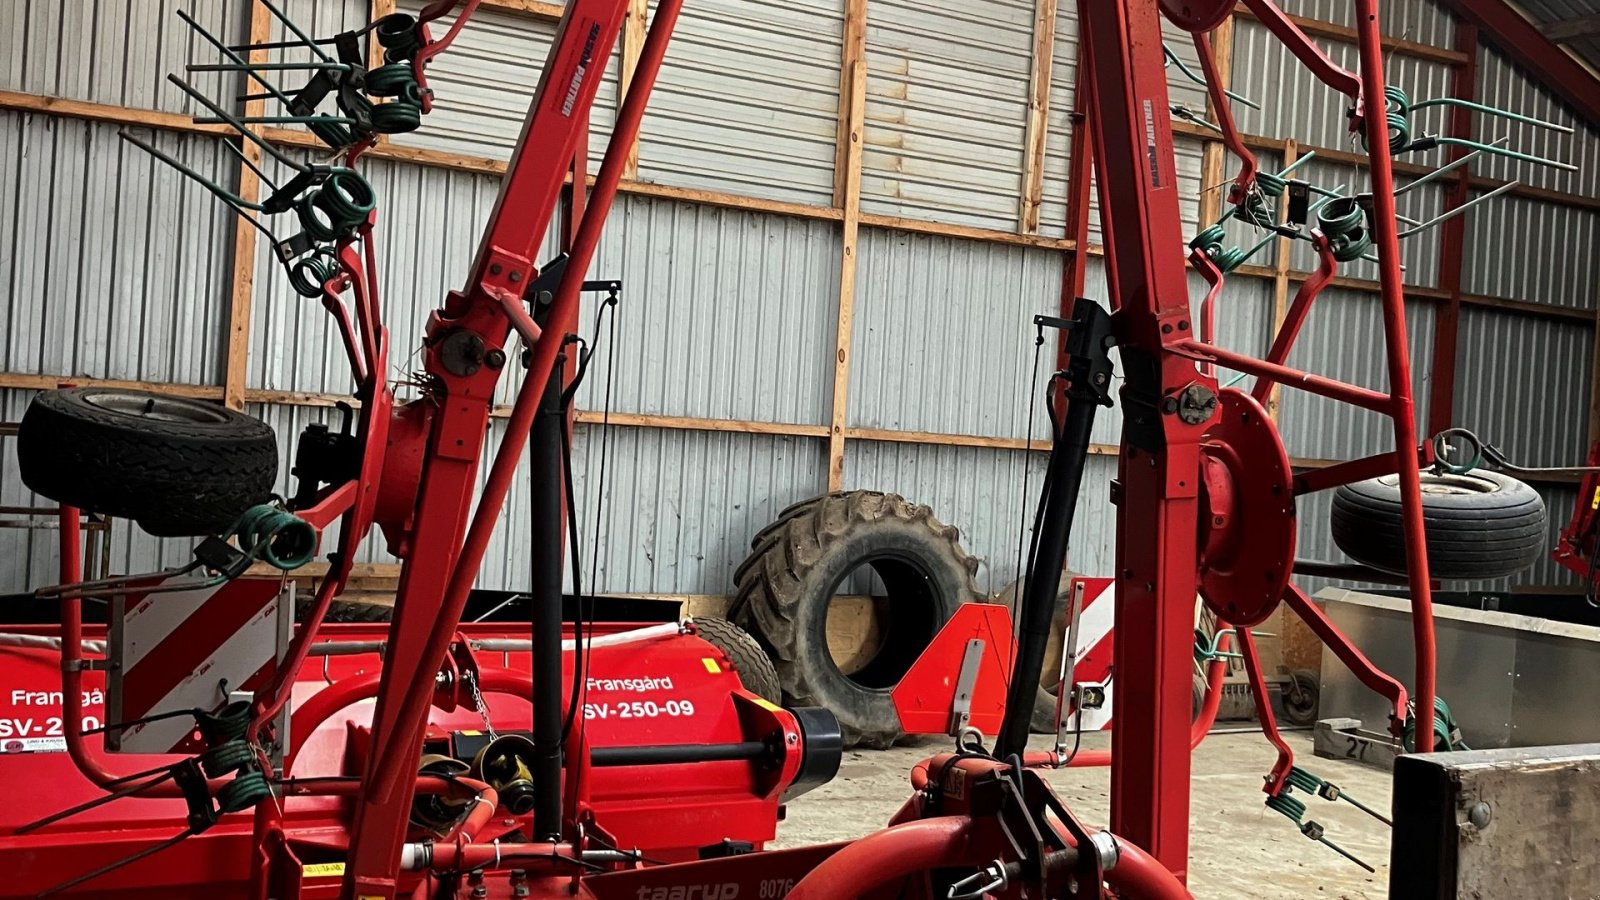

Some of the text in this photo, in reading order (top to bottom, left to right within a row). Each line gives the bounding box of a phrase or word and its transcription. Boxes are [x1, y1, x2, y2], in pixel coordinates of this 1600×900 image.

[561, 65, 586, 117] PARTNER
[1143, 99, 1155, 146] PARTNER
[586, 676, 673, 692] Fransgård
[11, 688, 105, 707] Frangå
[581, 700, 694, 719] SV-250-09
